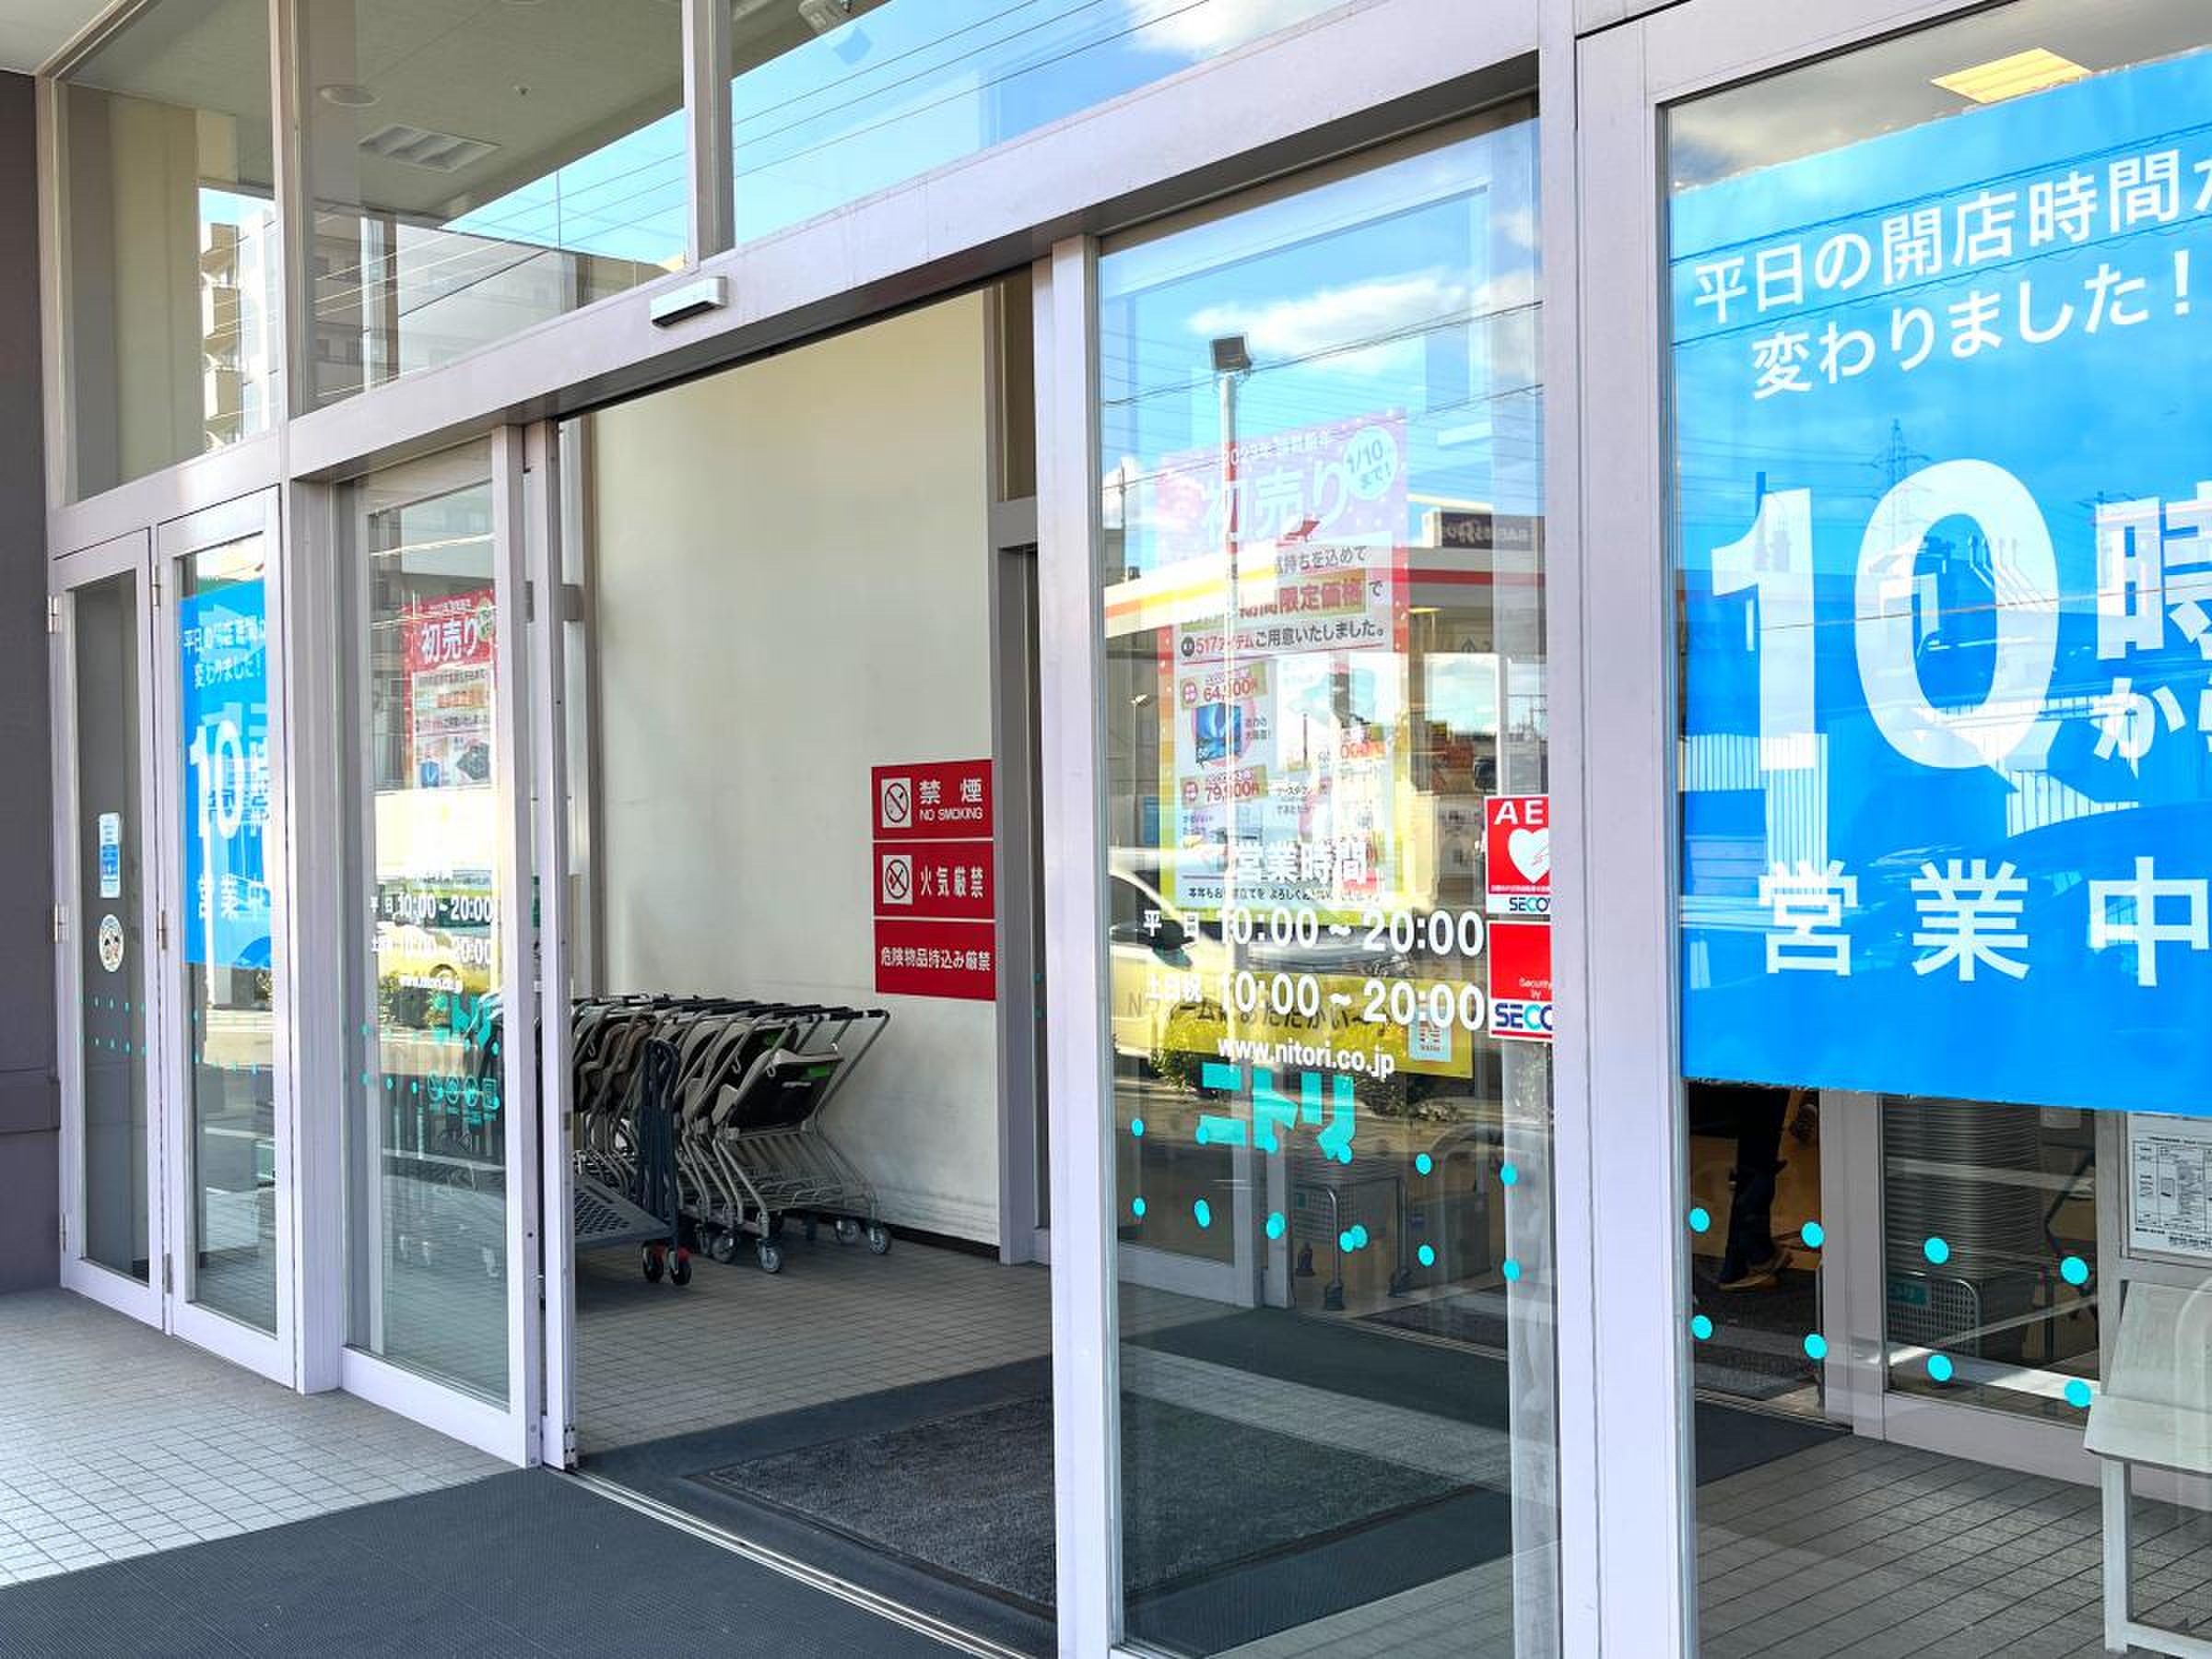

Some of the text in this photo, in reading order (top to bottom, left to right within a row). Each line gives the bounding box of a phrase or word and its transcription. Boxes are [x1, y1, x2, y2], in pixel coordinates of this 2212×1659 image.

[1694, 149, 2212, 324] 平日の開店時間
[1752, 250, 2190, 400] 変わりました！
[919, 806, 983, 821] NO SMOKING
[1494, 800, 1544, 826] AE
[920, 865, 983, 899] 火気厳禁
[1237, 839, 1367, 885] 営業時間
[1509, 897, 1551, 912] SECO
[1759, 855, 2210, 987] 営業中
[1494, 1002, 1553, 1031] SECO
[1218, 1037, 1395, 1082] www.nitori.co.jp
[1199, 1061, 1357, 1161] ニトリ
